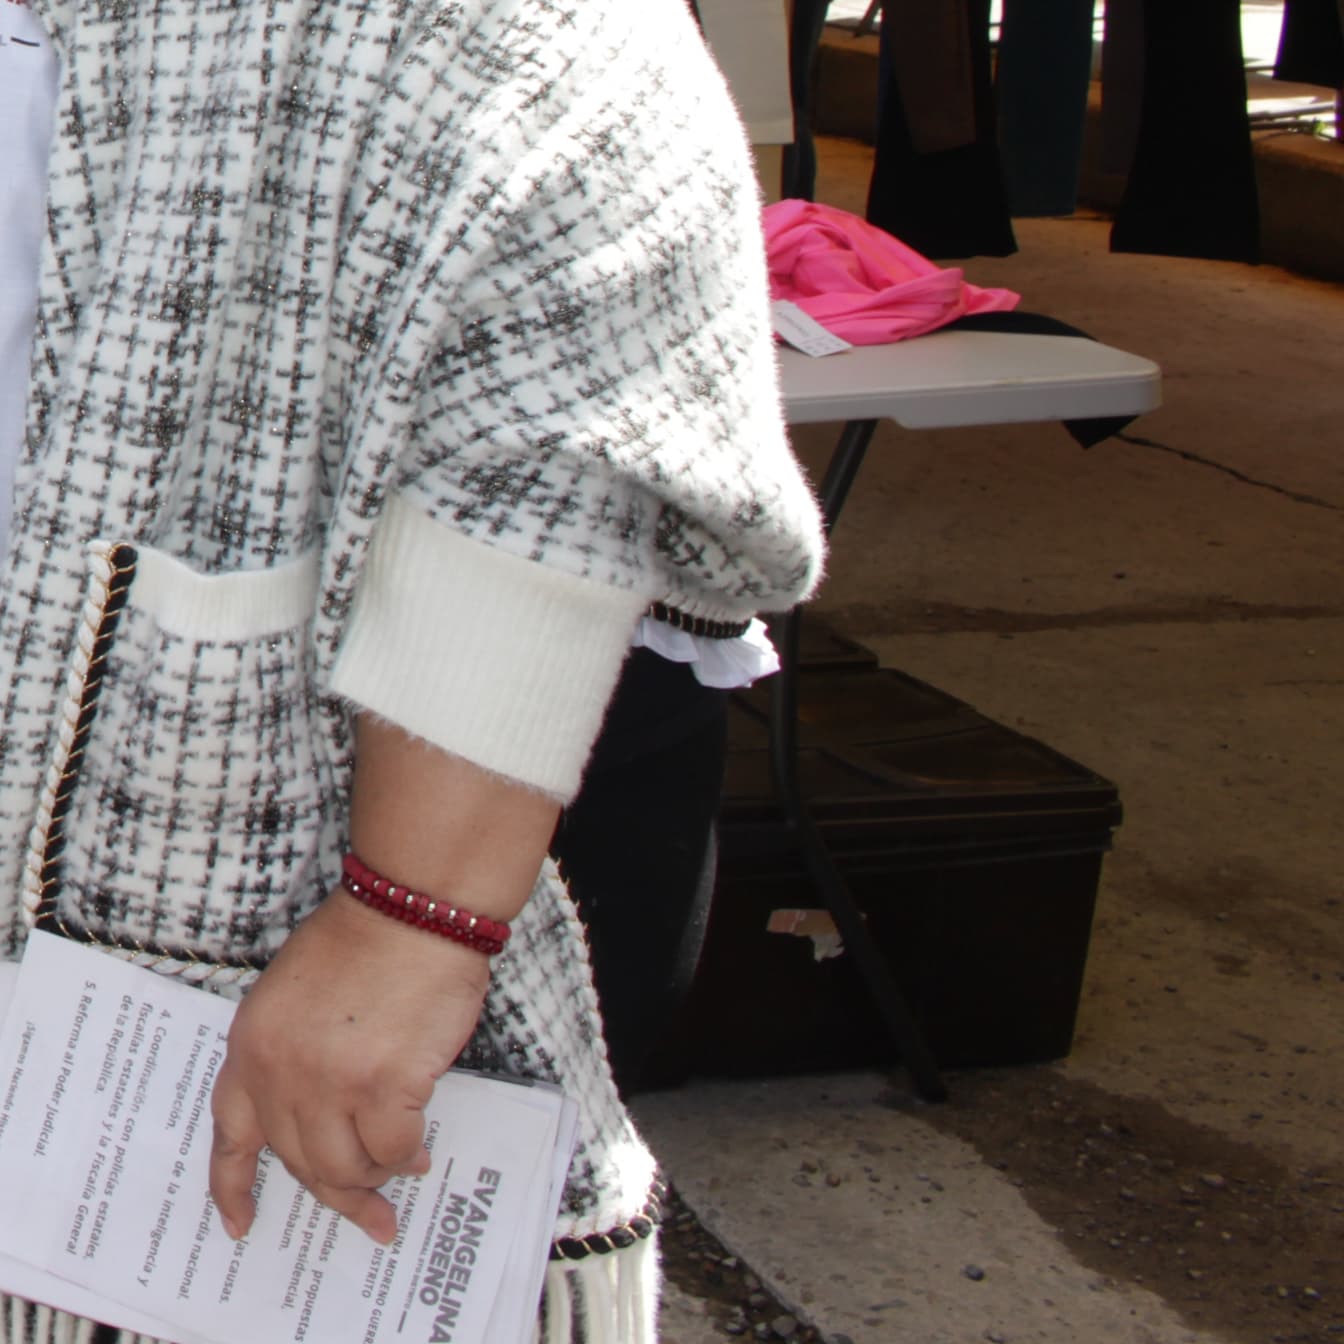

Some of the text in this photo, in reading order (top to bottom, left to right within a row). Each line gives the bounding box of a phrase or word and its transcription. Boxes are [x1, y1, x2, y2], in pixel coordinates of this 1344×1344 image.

[90, 993, 134, 1097] de la República.
[158, 1007, 172, 1022] 4.
[0, 1065, 24, 1112] Haciendo
[30, 979, 96, 1159] 5. Reforma al Poder Judicial.
[127, 1024, 168, 1115] Coordinación
[161, 1022, 211, 1133] la investigación.
[175, 1047, 223, 1158] Fortalecimiento
[64, 1000, 153, 1256] fiscalías estatales y la Fiscalía General
[119, 1116, 137, 1143] con
[100, 1144, 128, 1198] policías
[164, 1181, 181, 1196] la
[169, 1159, 187, 1179] de
[138, 1197, 176, 1275] inteligencia
[389, 1185, 420, 1256] EVANGELINA
[416, 1191, 468, 1308] MORENO
[428, 1166, 502, 1344] EVANGELINA
[135, 1275, 151, 1288] y
[176, 1242, 204, 1302] nacional.
[217, 1258, 242, 1306] causas.
[279, 1229, 315, 1312] presidencial,
[293, 1269, 325, 1343] propuestas
[360, 1246, 384, 1299] DISTRITO
[374, 1257, 399, 1307] MORENO
